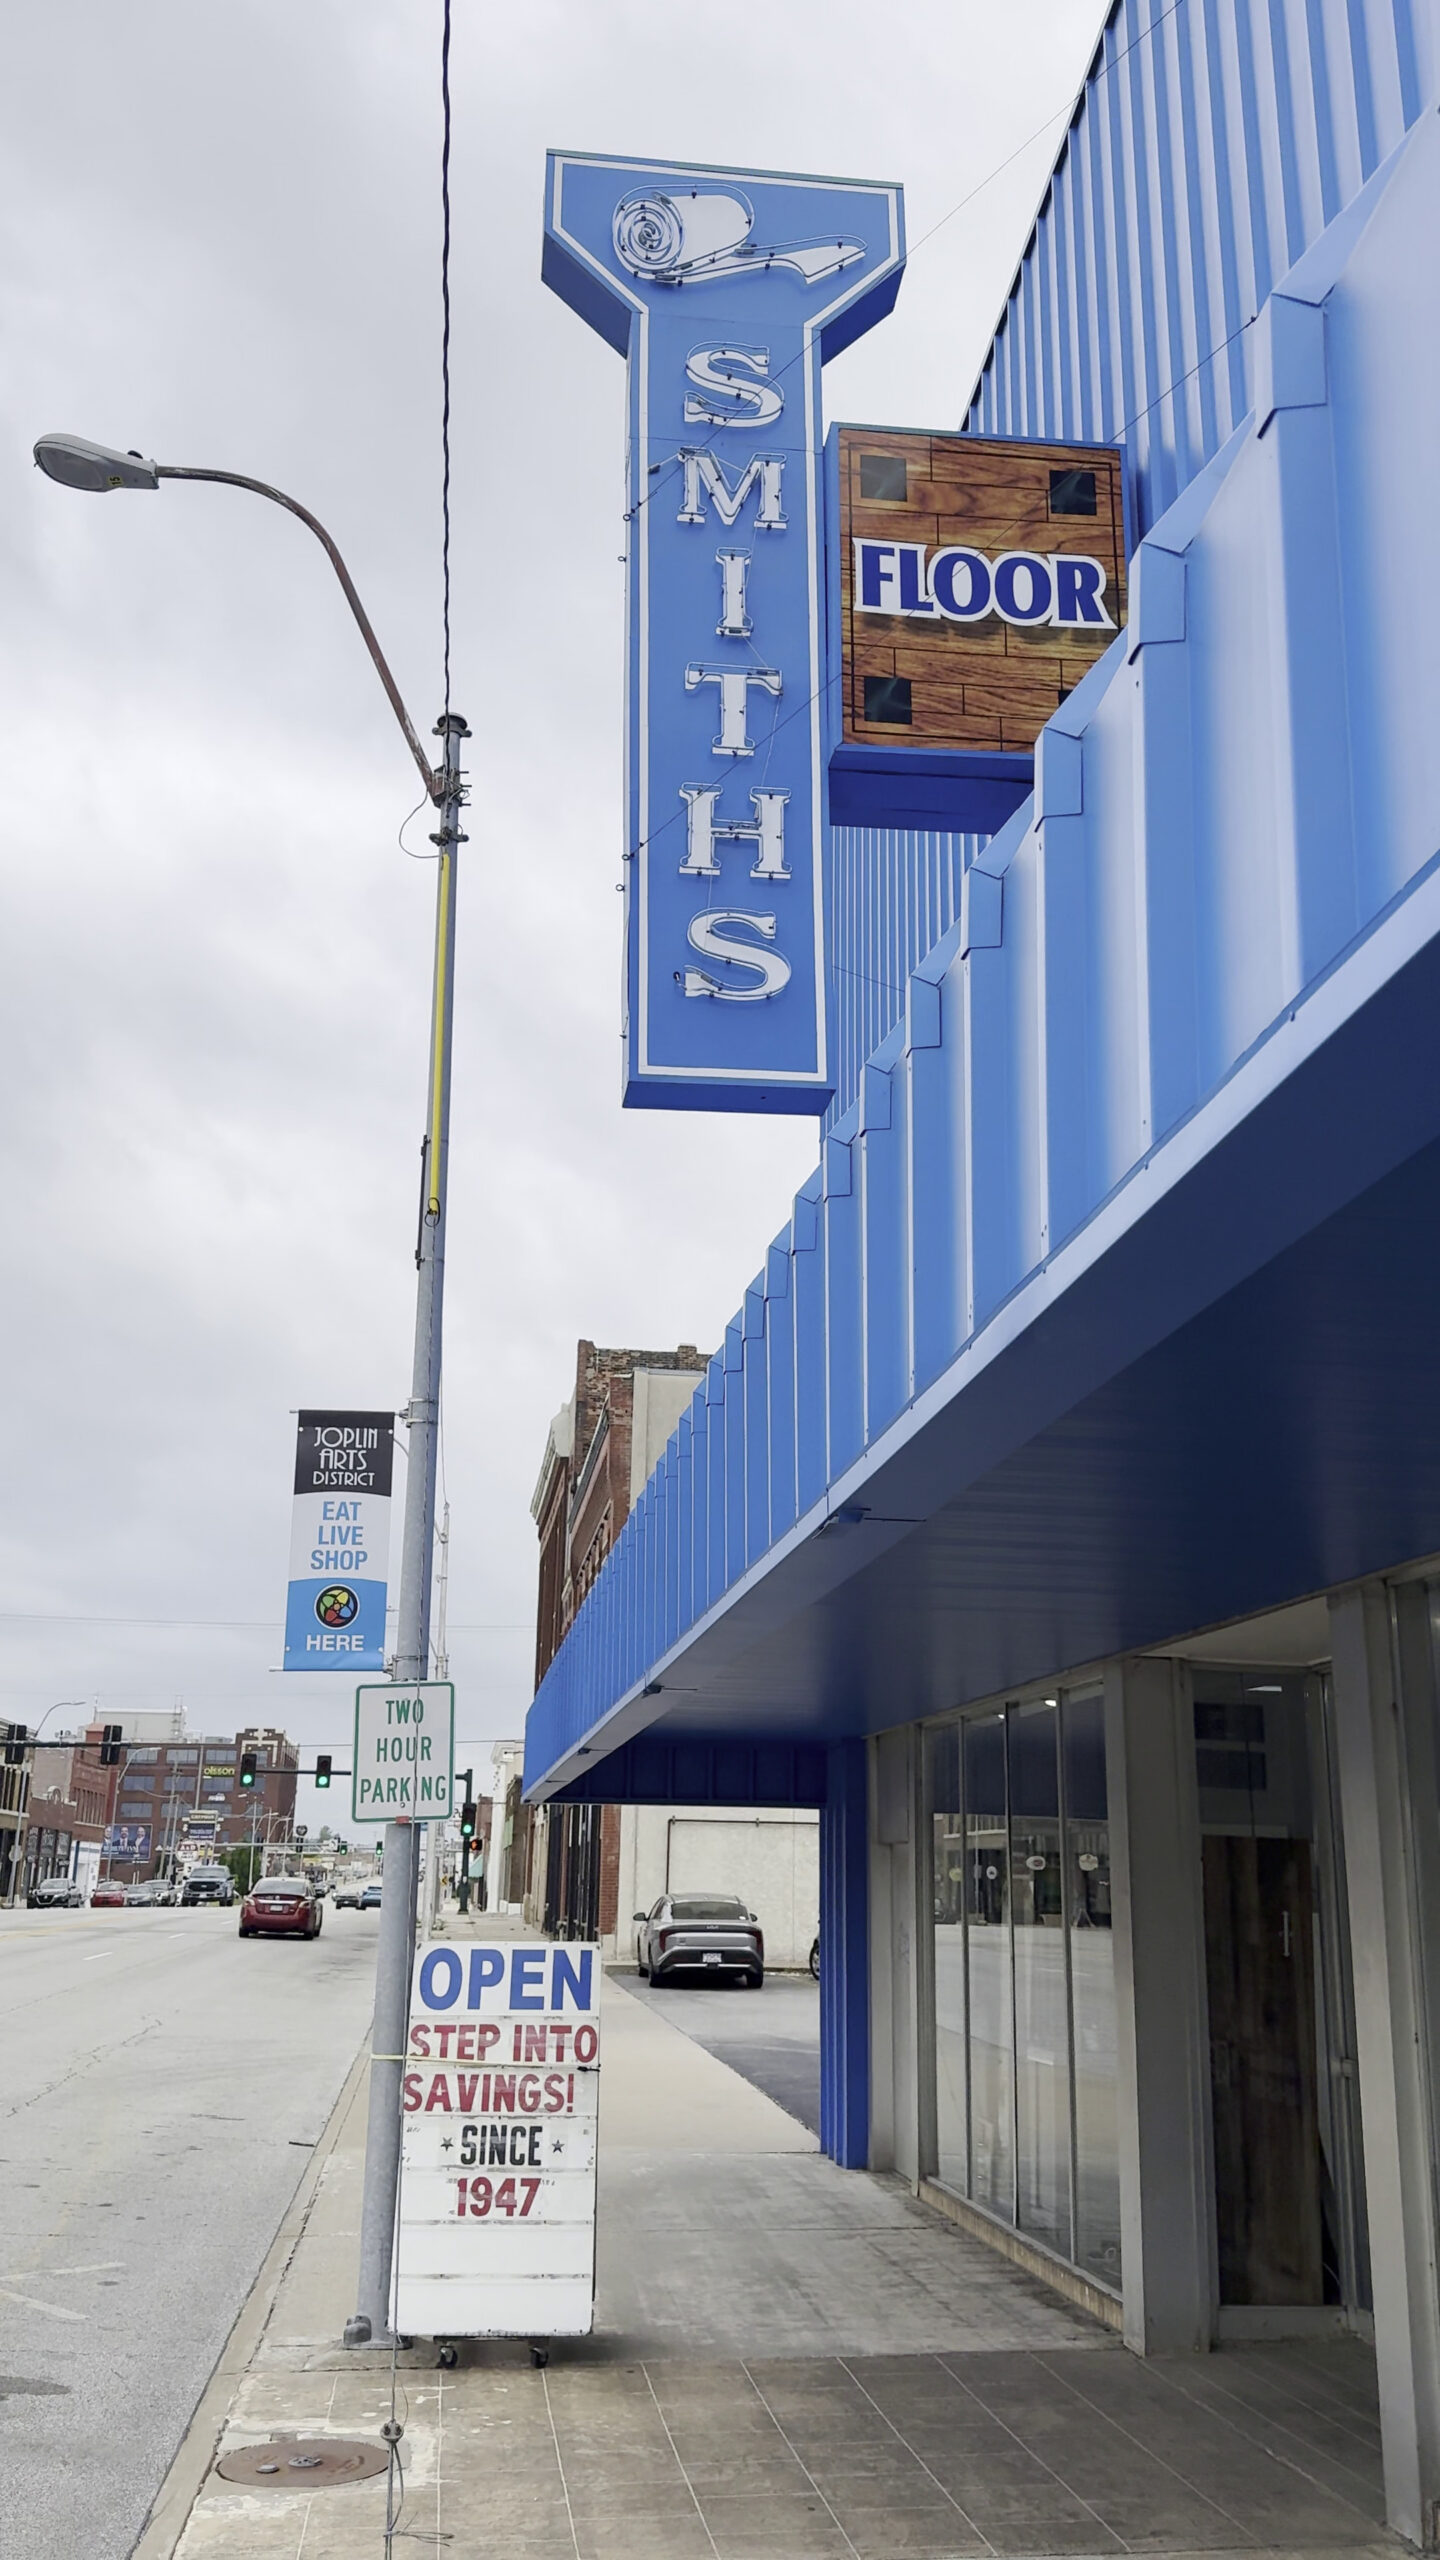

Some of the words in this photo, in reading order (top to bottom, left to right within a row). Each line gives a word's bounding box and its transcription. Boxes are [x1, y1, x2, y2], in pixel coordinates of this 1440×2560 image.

[854, 538, 1116, 630] FLOOR
[677, 342, 793, 1002] SMITHS
[313, 1427, 378, 1448] JOPLIN
[319, 1448, 367, 1470] ARTS
[312, 1471, 375, 1487] DISTRICT
[322, 1501, 362, 1521] EAT
[318, 1525, 363, 1546] LIVE
[310, 1550, 368, 1571] SHOP
[306, 1634, 365, 1652] HERE
[385, 1699, 424, 1724] TWO
[376, 1736, 432, 1762] HOUR
[203, 1766, 235, 1775] olsson
[419, 1948, 593, 2011] OPEN
[409, 2023, 501, 2062] STEP
[513, 2023, 598, 2062] INTO
[403, 2073, 574, 2113] SAVINGS!
[460, 2124, 543, 2166] SINCE
[456, 2176, 541, 2217] 1947
